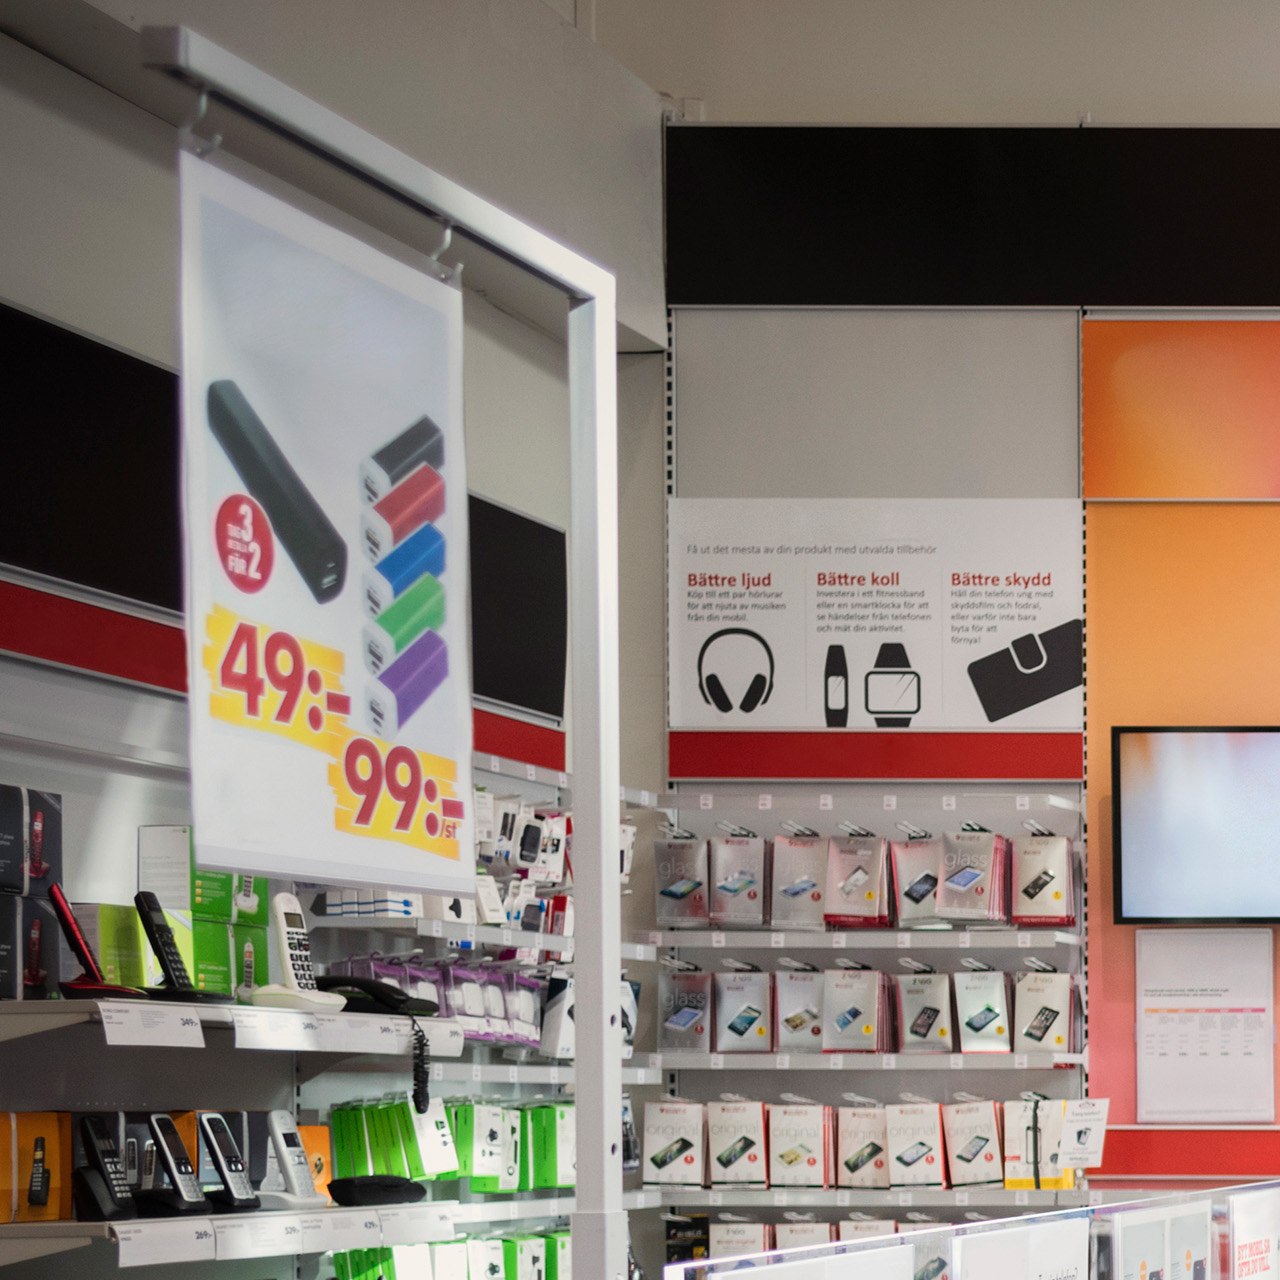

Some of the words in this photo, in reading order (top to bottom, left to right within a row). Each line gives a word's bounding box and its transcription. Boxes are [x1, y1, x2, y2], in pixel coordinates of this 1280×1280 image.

[240, 504, 253, 542] 3
[687, 544, 697, 554] Få
[700, 546, 710, 554] ut
[712, 545, 728, 554] det
[731, 546, 760, 554] mesta
[763, 546, 774, 554] av
[776, 545, 792, 554] din
[794, 545, 831, 554] produkt
[834, 546, 856, 554] med
[858, 546, 894, 554] utvalda
[896, 545, 936, 554] tillbehör
[248, 542, 262, 580] 2
[688, 573, 736, 586] Bättre
[742, 572, 770, 590] ljud
[817, 572, 865, 585] Bättre
[871, 572, 898, 585] koll
[951, 572, 999, 586] Bättre
[1005, 573, 1050, 588] skydd
[221, 622, 351, 731] 49:-
[344, 737, 464, 838] 99:-
[944, 849, 989, 869] glass
[663, 988, 707, 1010] glass
[711, 1119, 759, 1139] original
[1238, 1243, 1248, 1260] BYT
[1252, 1258, 1257, 1274] DU
